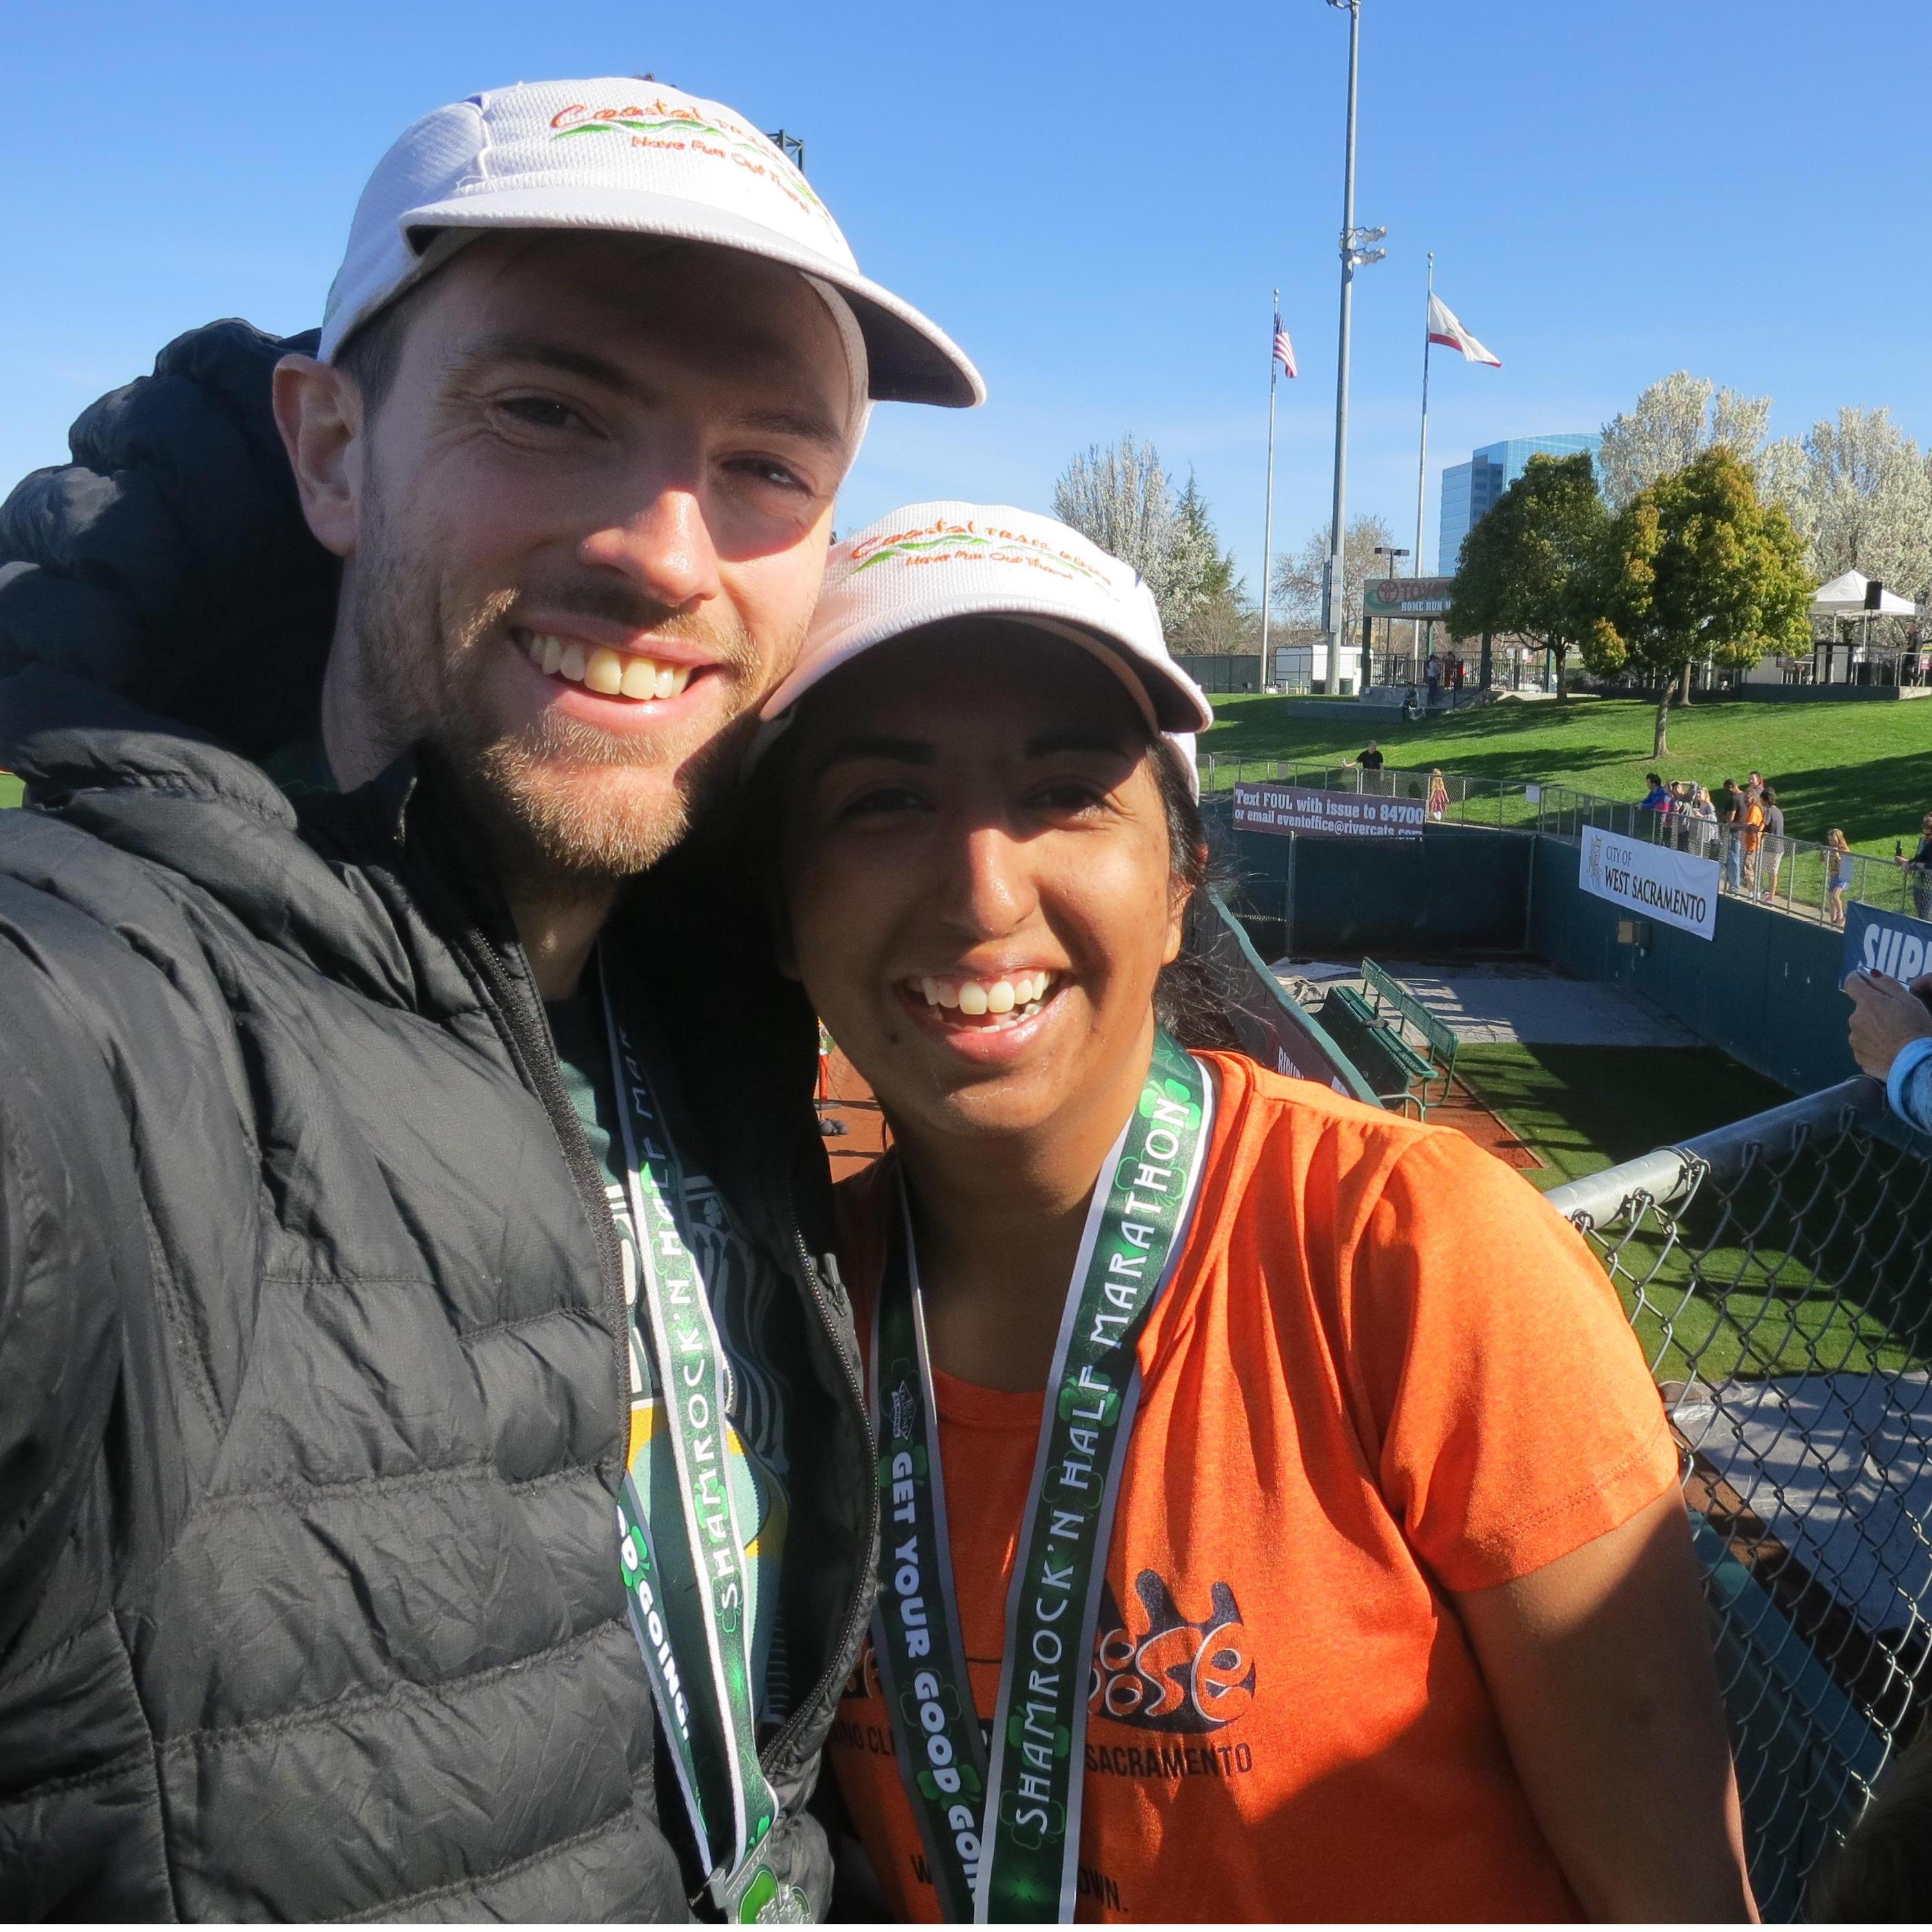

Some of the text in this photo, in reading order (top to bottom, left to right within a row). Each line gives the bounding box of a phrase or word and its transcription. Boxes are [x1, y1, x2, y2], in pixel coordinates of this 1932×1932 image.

[550, 98, 705, 128] Coastal
[632, 135, 686, 150] Have
[692, 139, 725, 159] Fun
[852, 517, 976, 559] Coastal
[905, 552, 951, 566] Have
[1401, 601, 1424, 612] HOME
[1426, 601, 1443, 612] RUN
[1234, 808, 1245, 819] or
[1247, 810, 1275, 824] email
[1235, 788, 1424, 825] Text FOUL with issue to 84700
[1606, 845, 1632, 867] CITY OF
[1605, 866, 1706, 923] WEST SACRAMENTO
[1864, 923, 1932, 983] SUP
[1060, 1365, 1110, 1490] HALF
[1090, 1097, 1191, 1350] MARATHON
[892, 1451, 916, 1524] GET
[894, 1535, 930, 1659] YOUR
[914, 1672, 961, 1793] GOOD
[1085, 1743, 1253, 1778] SACRAMENTO
